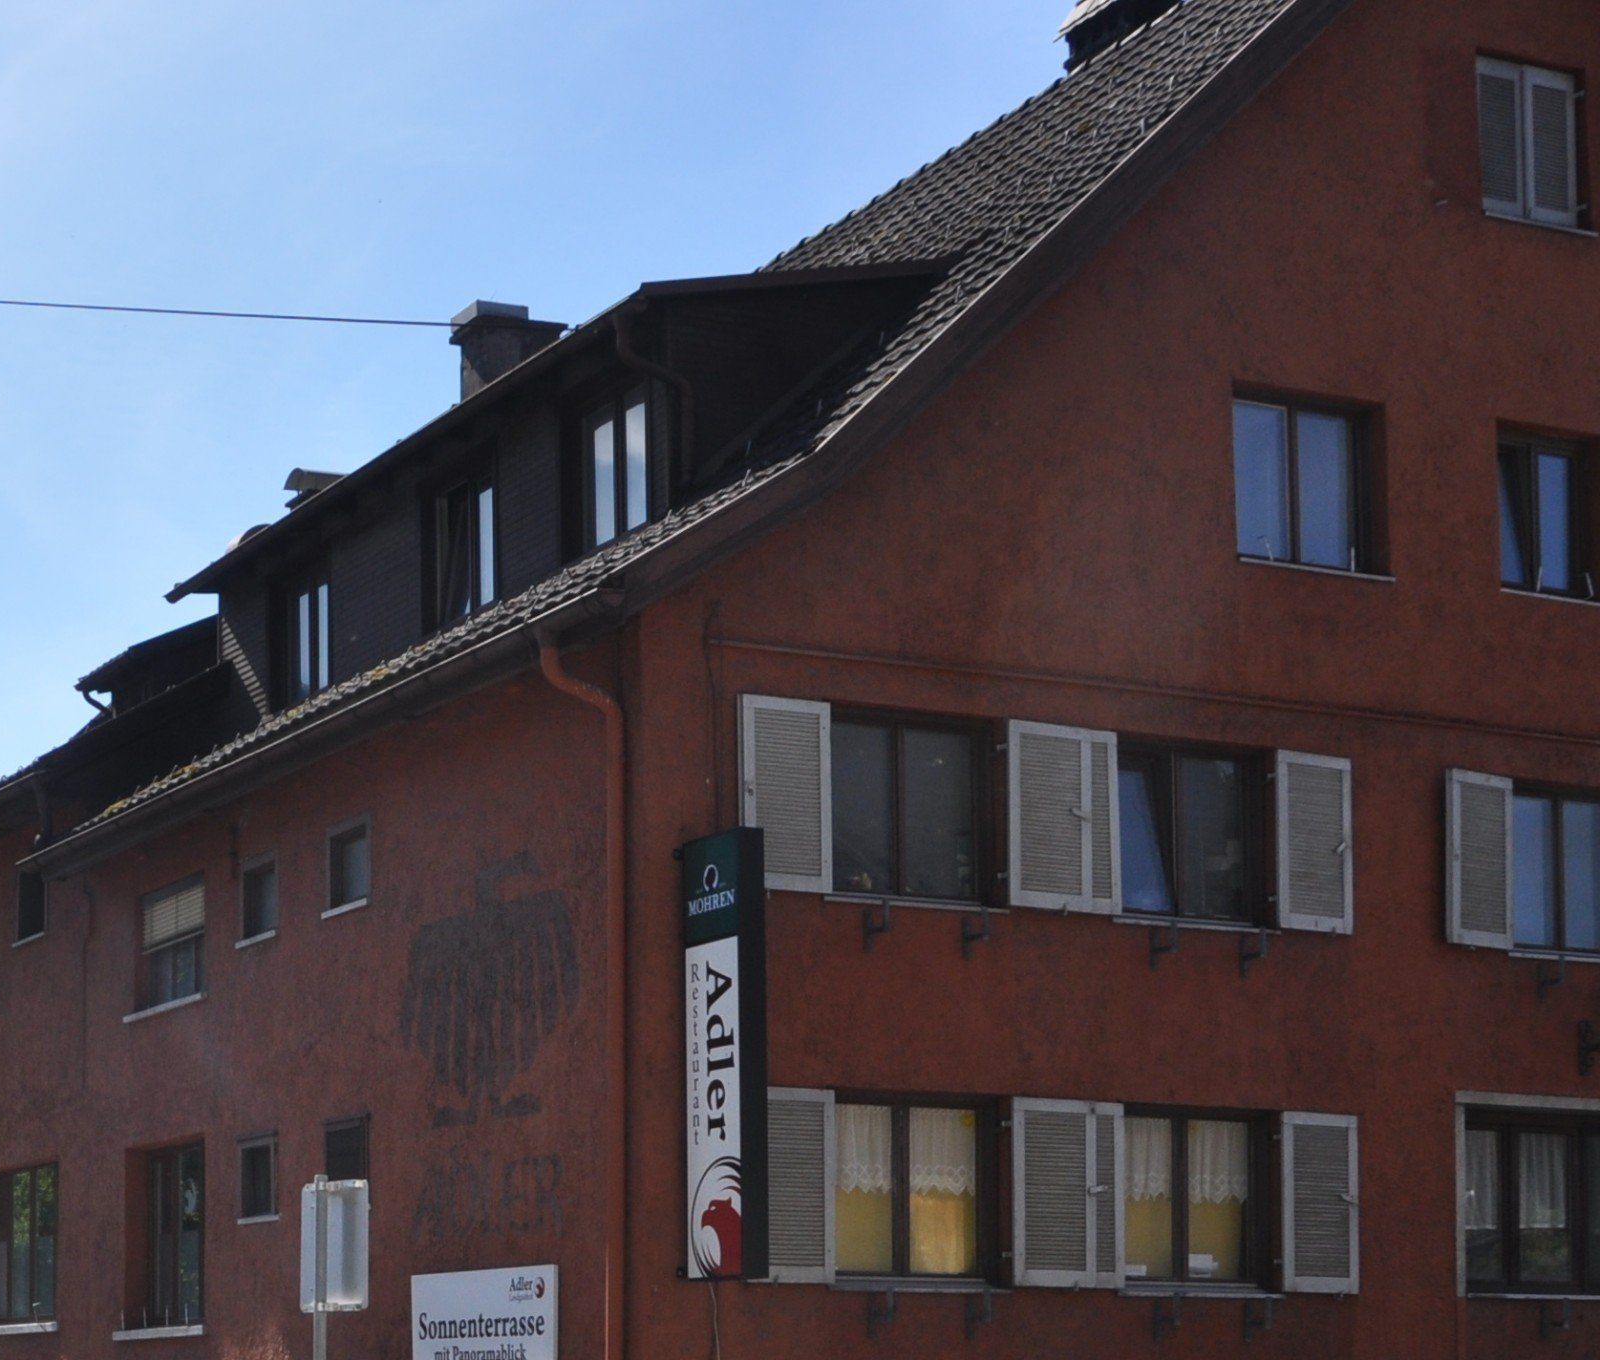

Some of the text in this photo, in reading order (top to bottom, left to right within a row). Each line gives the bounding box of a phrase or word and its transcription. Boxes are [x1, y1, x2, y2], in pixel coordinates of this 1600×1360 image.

[688, 888, 736, 917] MOHREN
[689, 962, 702, 1147] Restaurant
[705, 960, 736, 1142] Adler
[509, 1276, 533, 1293] Adler
[418, 1312, 545, 1340] Sonnenterrasse
